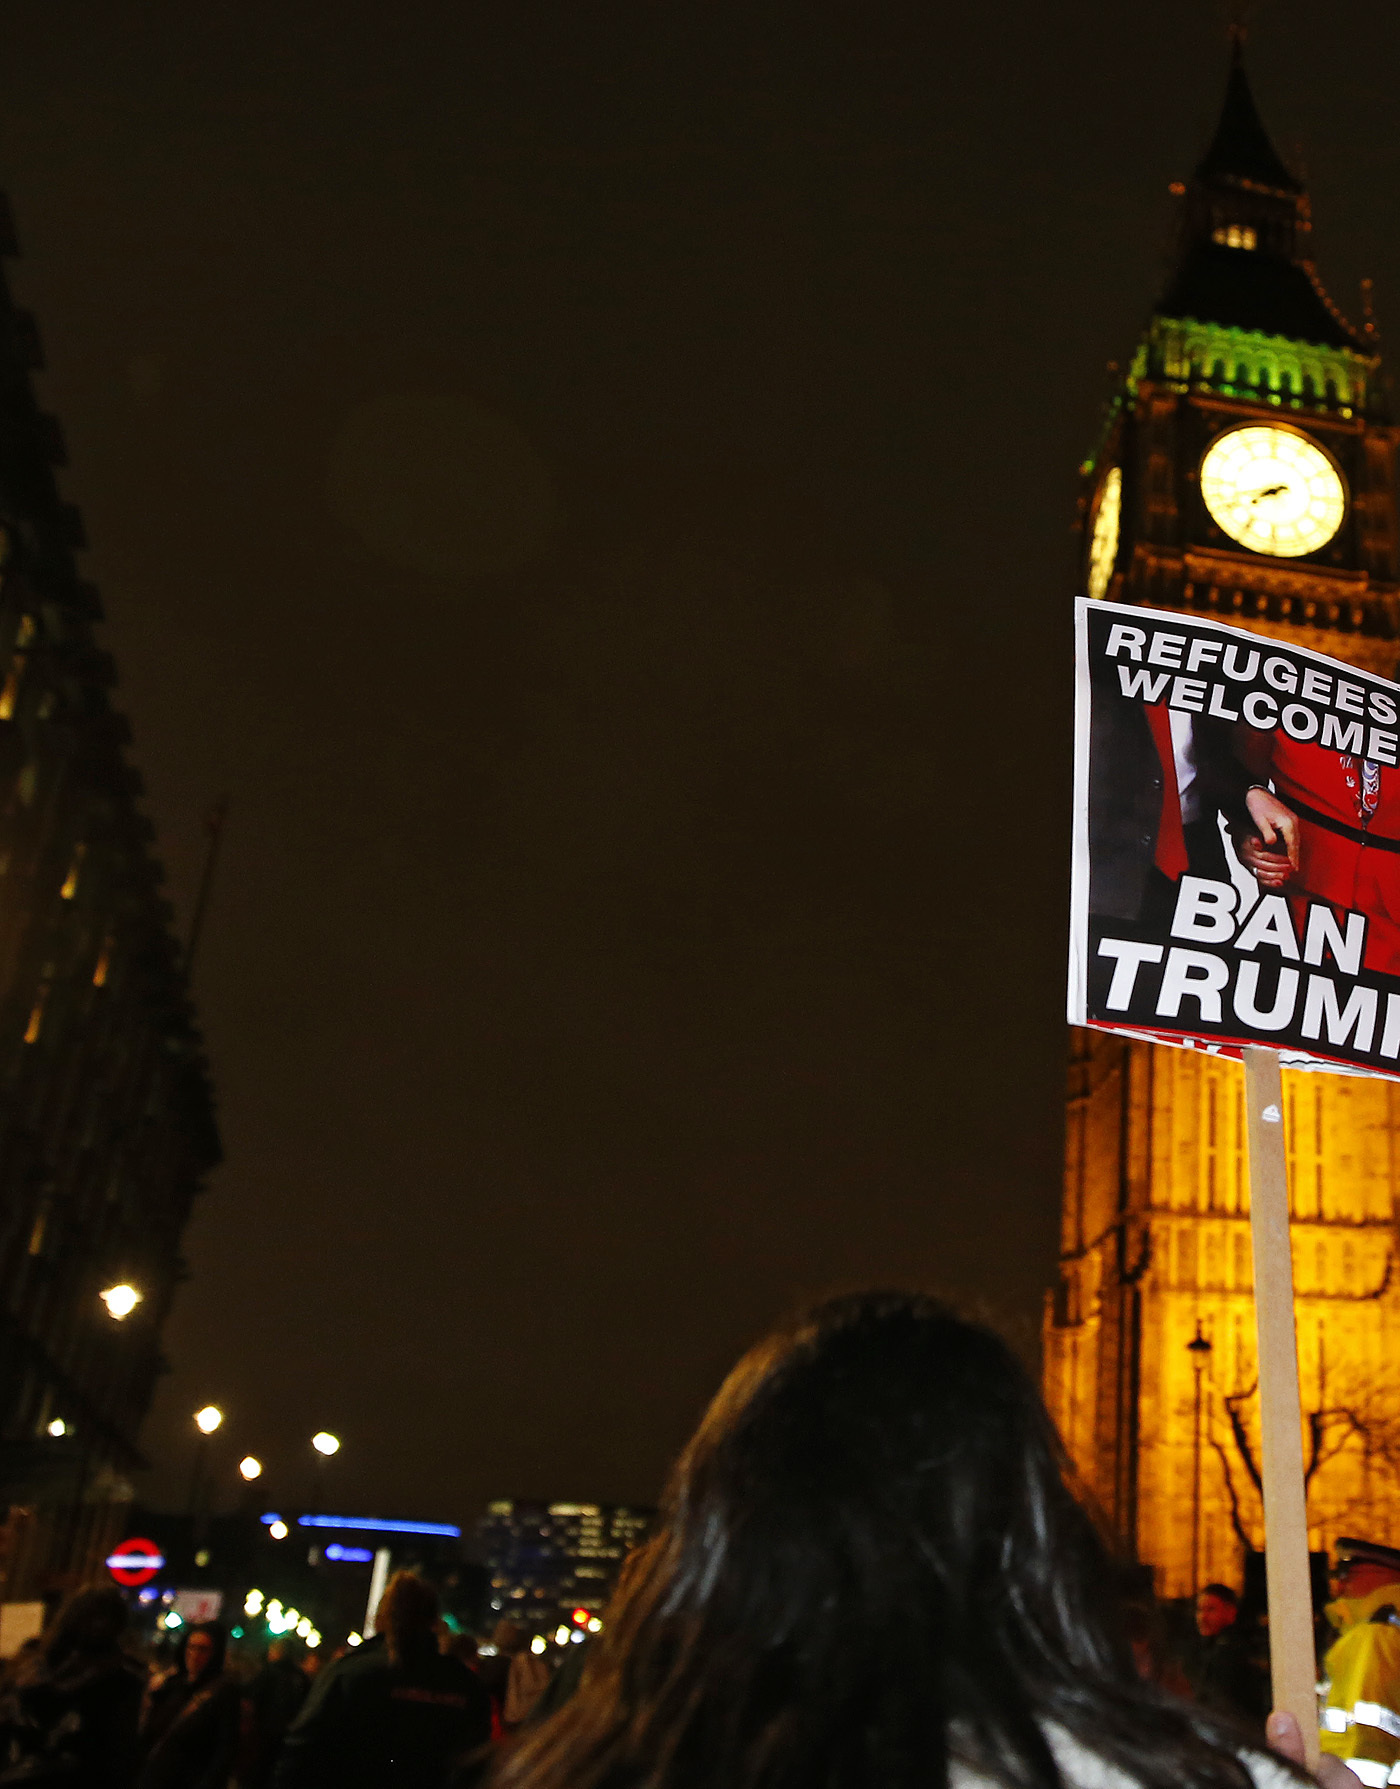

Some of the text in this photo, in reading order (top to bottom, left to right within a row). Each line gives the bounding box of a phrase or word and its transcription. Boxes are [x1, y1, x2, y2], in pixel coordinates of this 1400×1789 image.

[1105, 623, 1398, 725] REFUGEES
[1117, 664, 1399, 765] WELCOME
[1170, 875, 1366, 975] BAN
